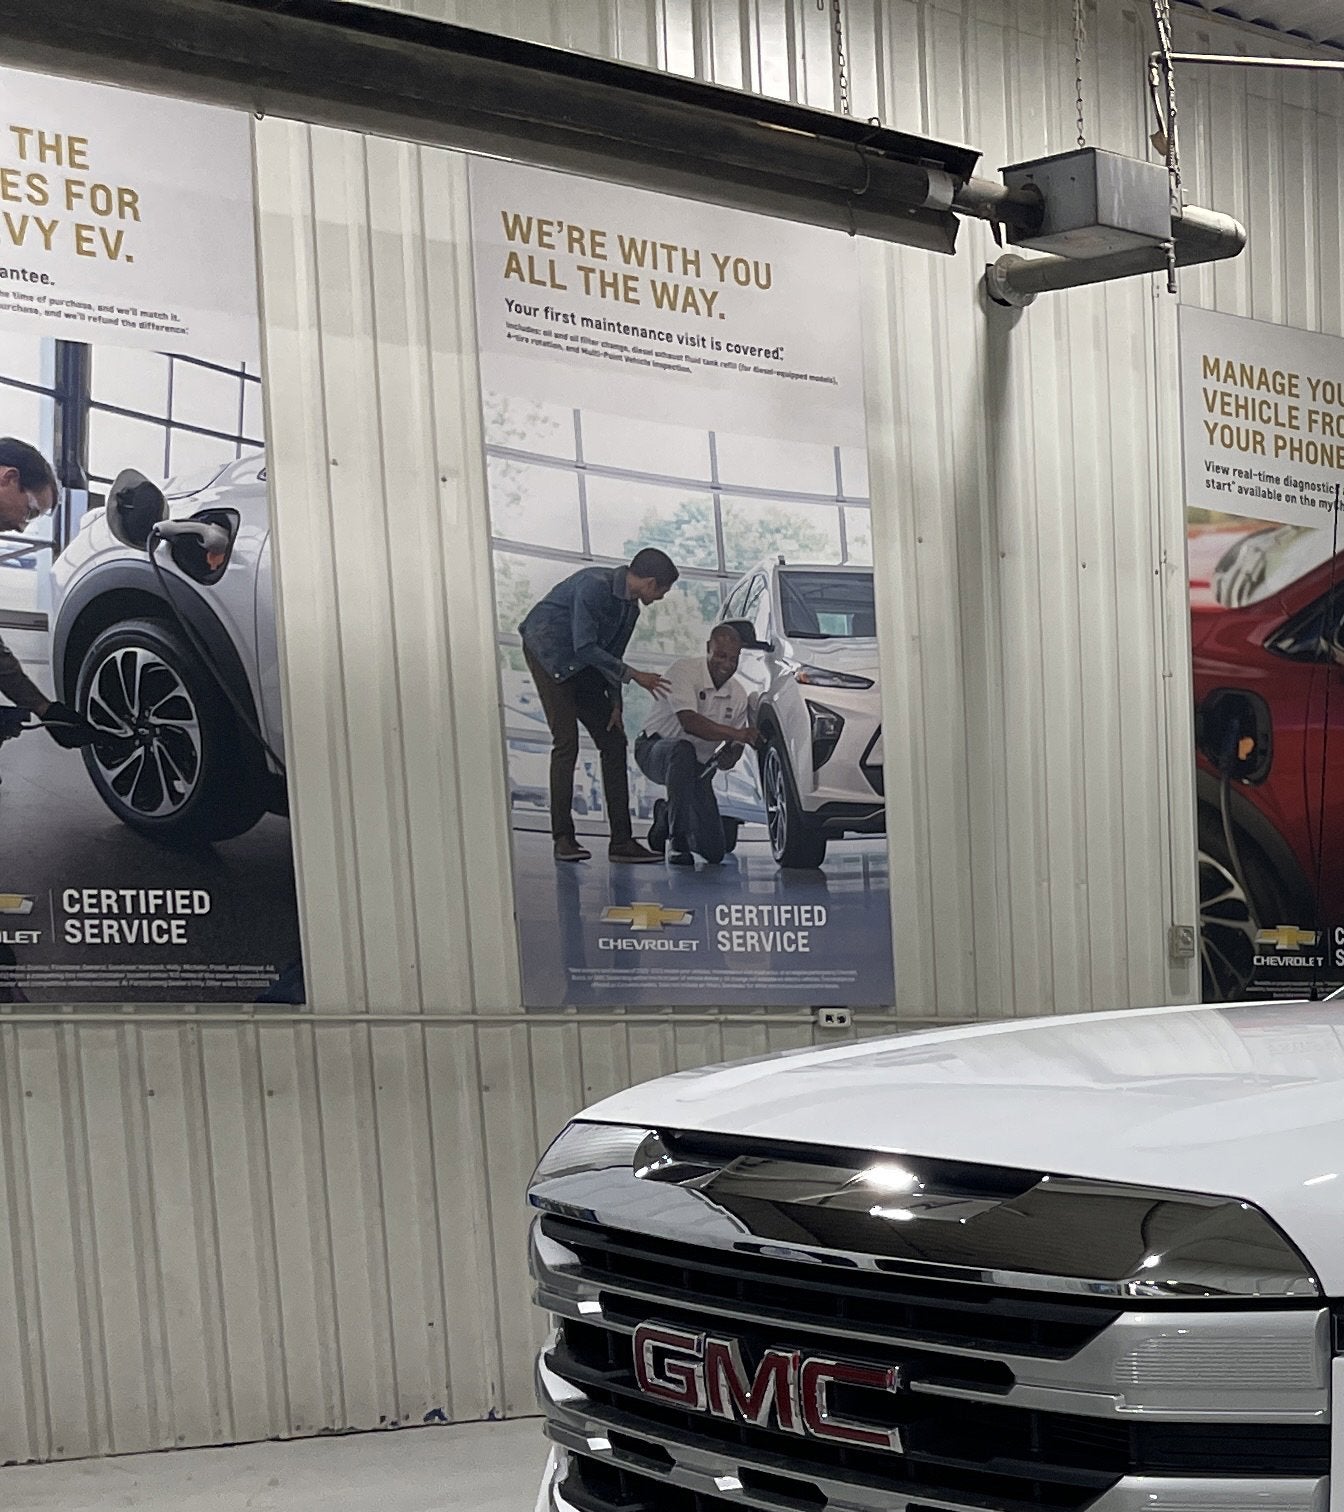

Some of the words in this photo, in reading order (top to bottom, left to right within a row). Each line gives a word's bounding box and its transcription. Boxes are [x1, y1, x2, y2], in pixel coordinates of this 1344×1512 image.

[9, 125, 90, 170] THE
[65, 179, 142, 222] FOR
[3, 211, 59, 251] VY
[75, 223, 134, 262] EV.
[617, 234, 701, 278] WITH
[711, 252, 773, 290] YOU
[504, 251, 567, 290] ALL
[577, 265, 640, 305] THE
[651, 279, 727, 320] WAY.
[505, 298, 539, 318] Your
[543, 306, 577, 326] first
[581, 316, 673, 344] maintenance
[677, 332, 707, 349] visit
[711, 337, 722, 351] is
[1203, 354, 1300, 399] MANAGE
[1203, 387, 1300, 431] VEHICLE
[1203, 420, 1266, 455] YOUR
[1204, 459, 1230, 475] View
[1232, 468, 1280, 485] real-time
[1237, 485, 1282, 502] available
[1285, 494, 1297, 504] on
[1299, 494, 1316, 507] the
[62, 889, 211, 914] CERTIFIED
[715, 904, 827, 926] CERTIFIED
[64, 919, 188, 944] SERVICE
[598, 938, 699, 951] CHEVROLET
[717, 930, 810, 952] SERVICE
[1253, 955, 1324, 967] CHEVROLET
[632, 1319, 904, 1454] GMC
